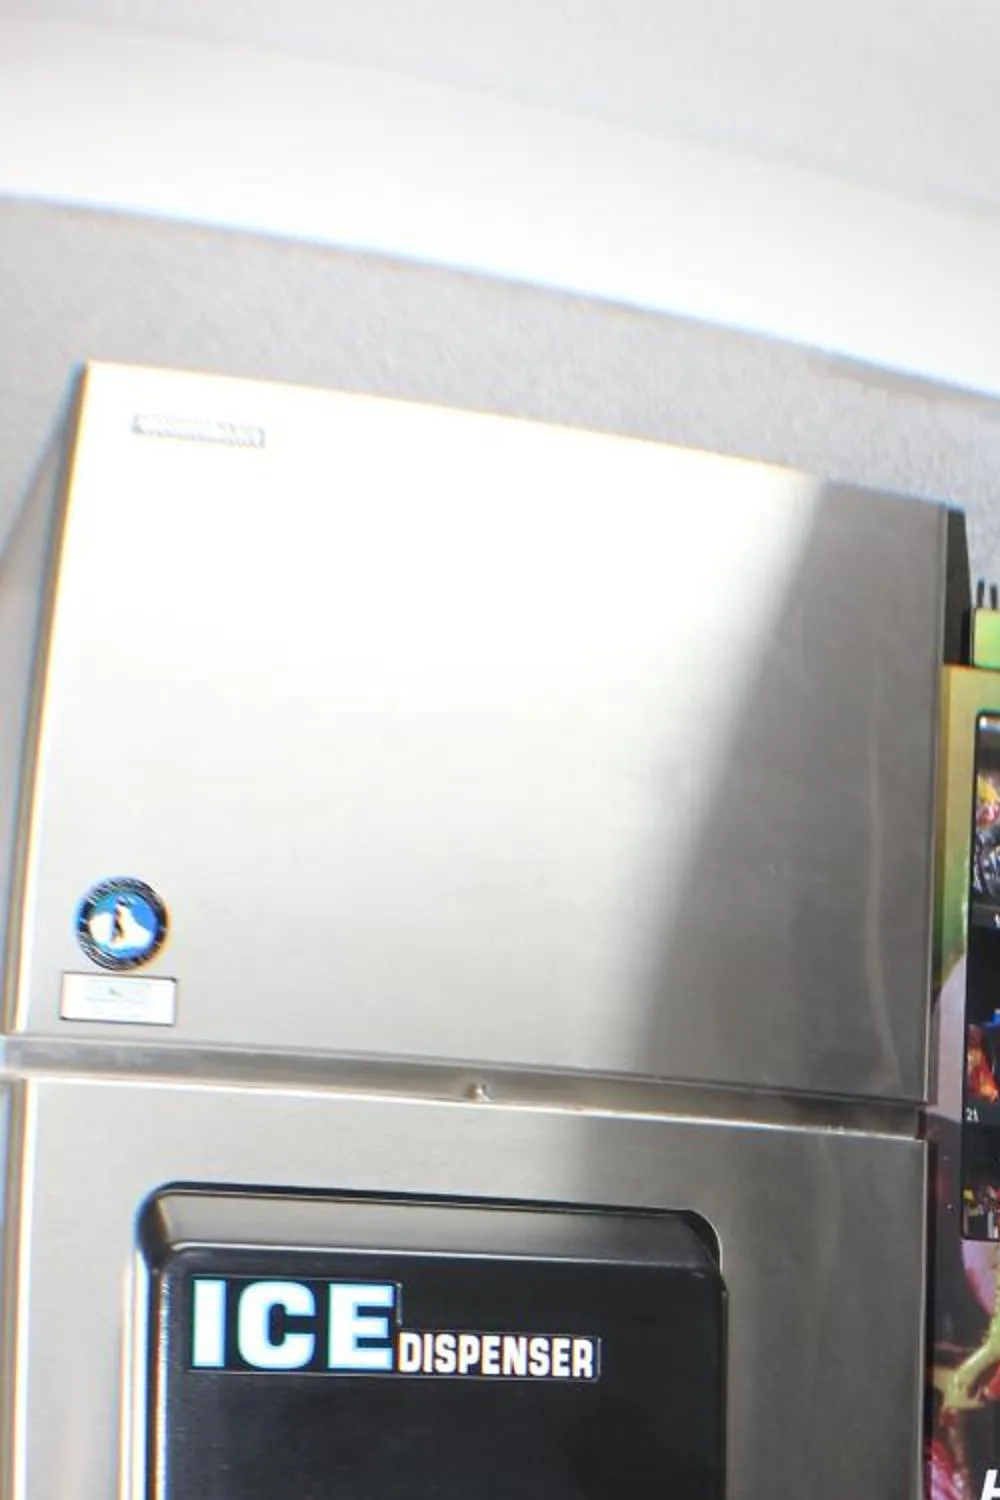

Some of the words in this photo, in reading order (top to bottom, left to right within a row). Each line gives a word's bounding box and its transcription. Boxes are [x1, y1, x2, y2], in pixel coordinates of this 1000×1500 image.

[965, 1107, 979, 1122] 21
[191, 1279, 394, 1369] ICE
[399, 1331, 593, 1377] DISPENSER
